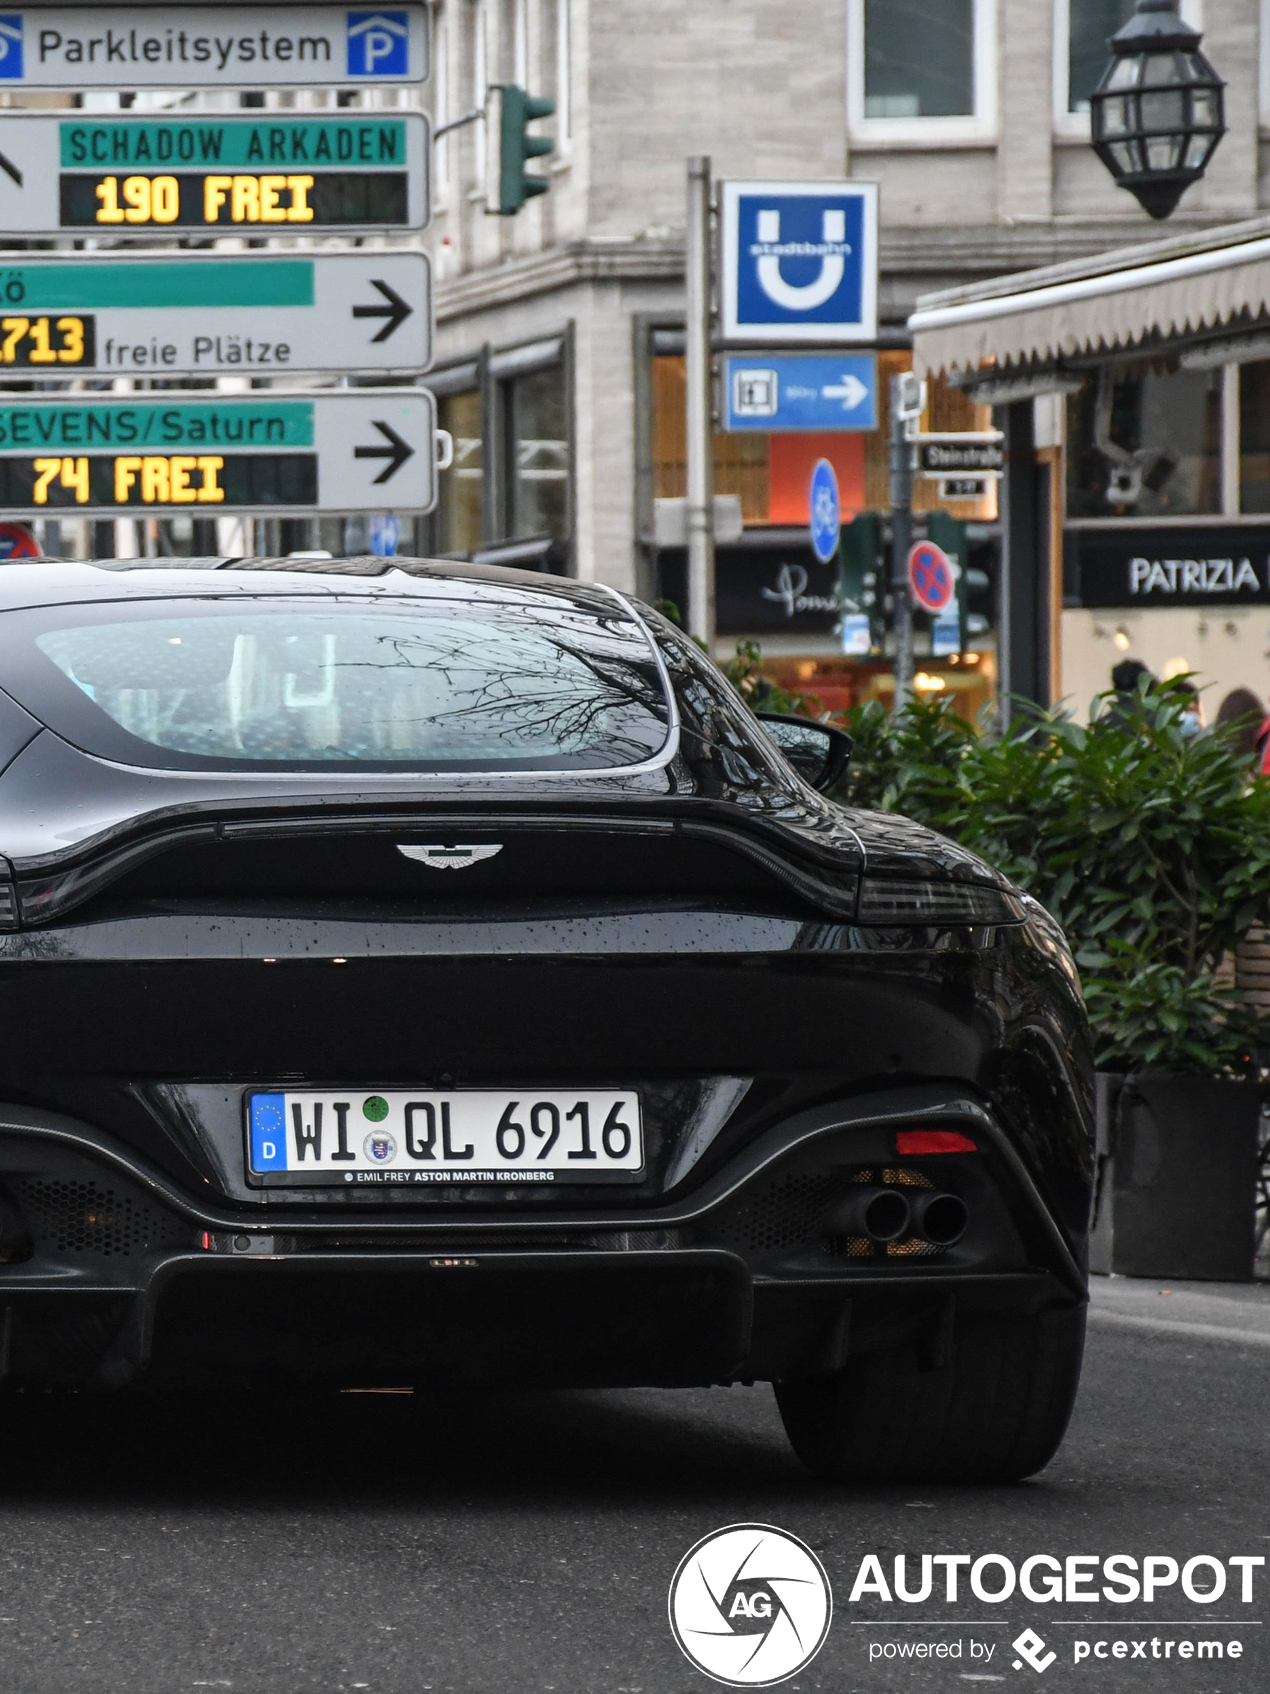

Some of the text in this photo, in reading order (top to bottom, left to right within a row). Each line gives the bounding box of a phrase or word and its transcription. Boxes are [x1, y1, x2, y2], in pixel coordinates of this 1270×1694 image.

[39, 30, 330, 68] Parkleitsystem
[70, 126, 397, 162] SCHADOW ARKADEN
[95, 175, 315, 223] 190 FREI
[749, 241, 852, 256] stadtbahn
[104, 336, 291, 365] freie Plätze
[33, 456, 224, 504] 74 FREI
[1130, 557, 1261, 594] PATRIZIA
[263, 1142, 276, 1160] D
[291, 1102, 356, 1161] WI
[405, 1101, 475, 1160] QL
[495, 1101, 631, 1160] 6916
[357, 1172, 555, 1182] EMIL FREY ASTON MARTIN KRONBERG
